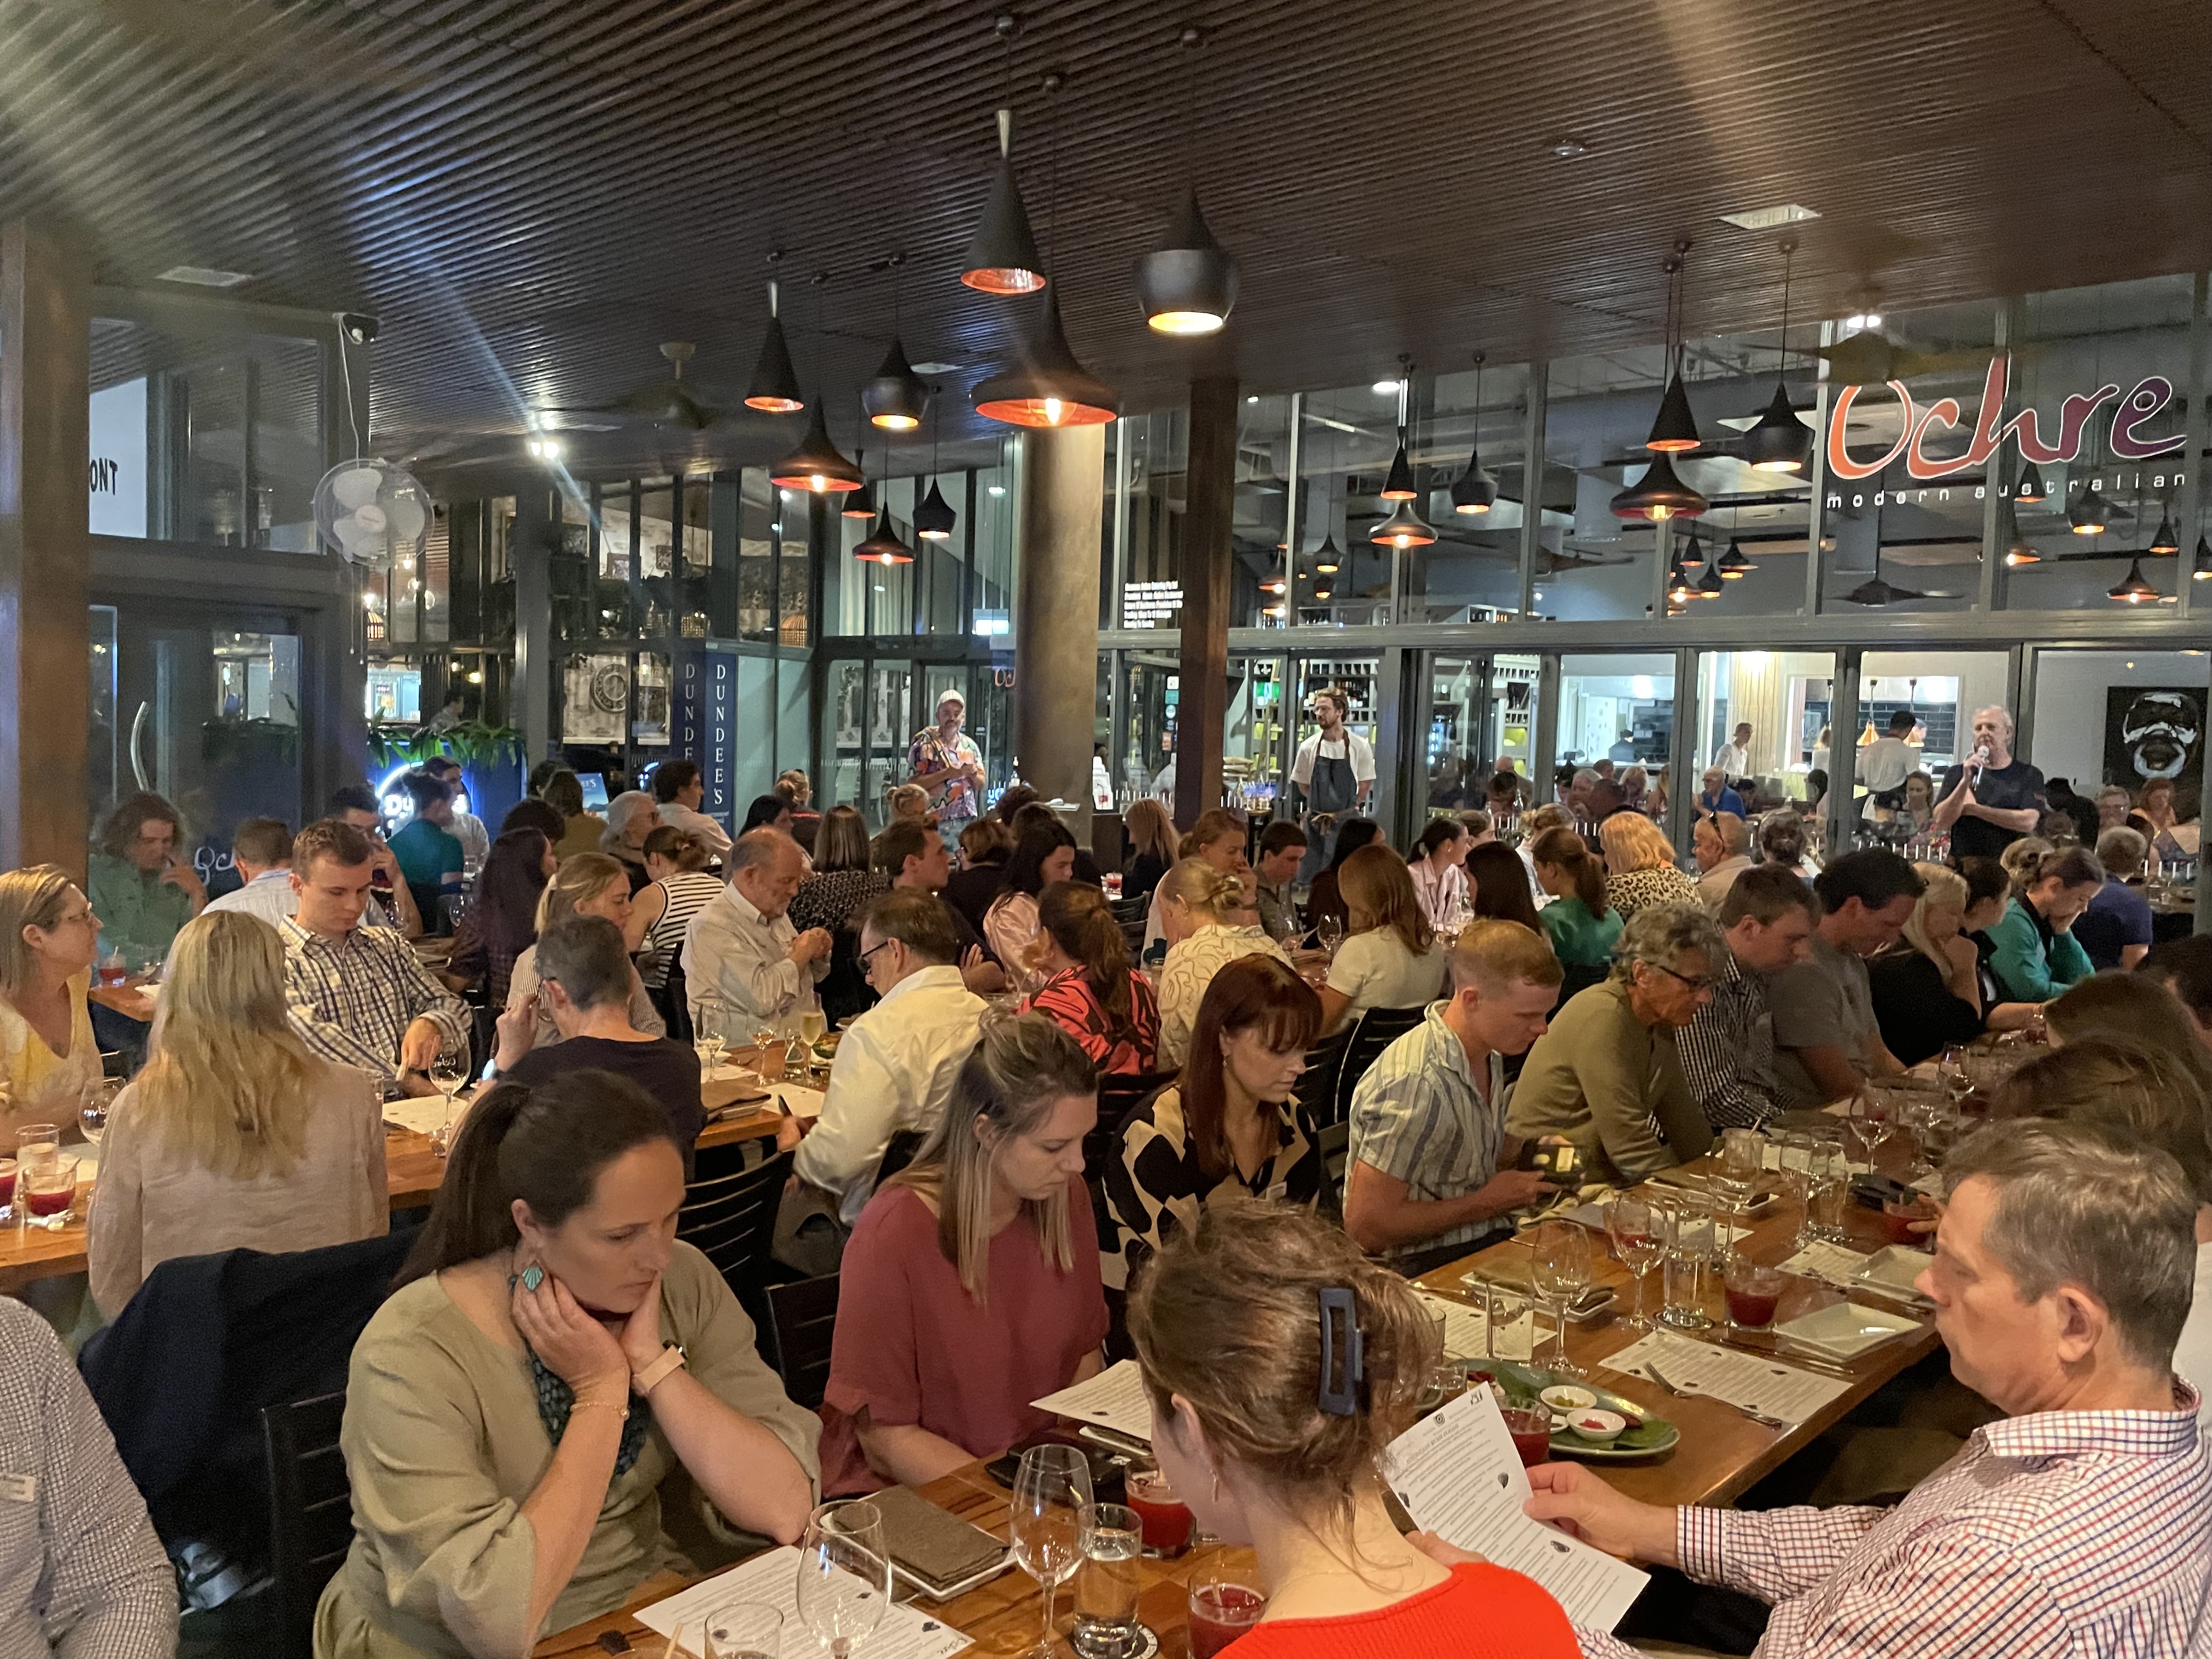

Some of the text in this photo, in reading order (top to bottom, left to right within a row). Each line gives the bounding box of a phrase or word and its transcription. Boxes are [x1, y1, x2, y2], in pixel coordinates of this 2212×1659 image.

[1828, 349, 2187, 479] Ochre
[90, 457, 118, 495] ONT
[1827, 473, 2185, 509] modern australian
[685, 663, 695, 761] DUNDE
[714, 664, 726, 805] DUNDEE'S
